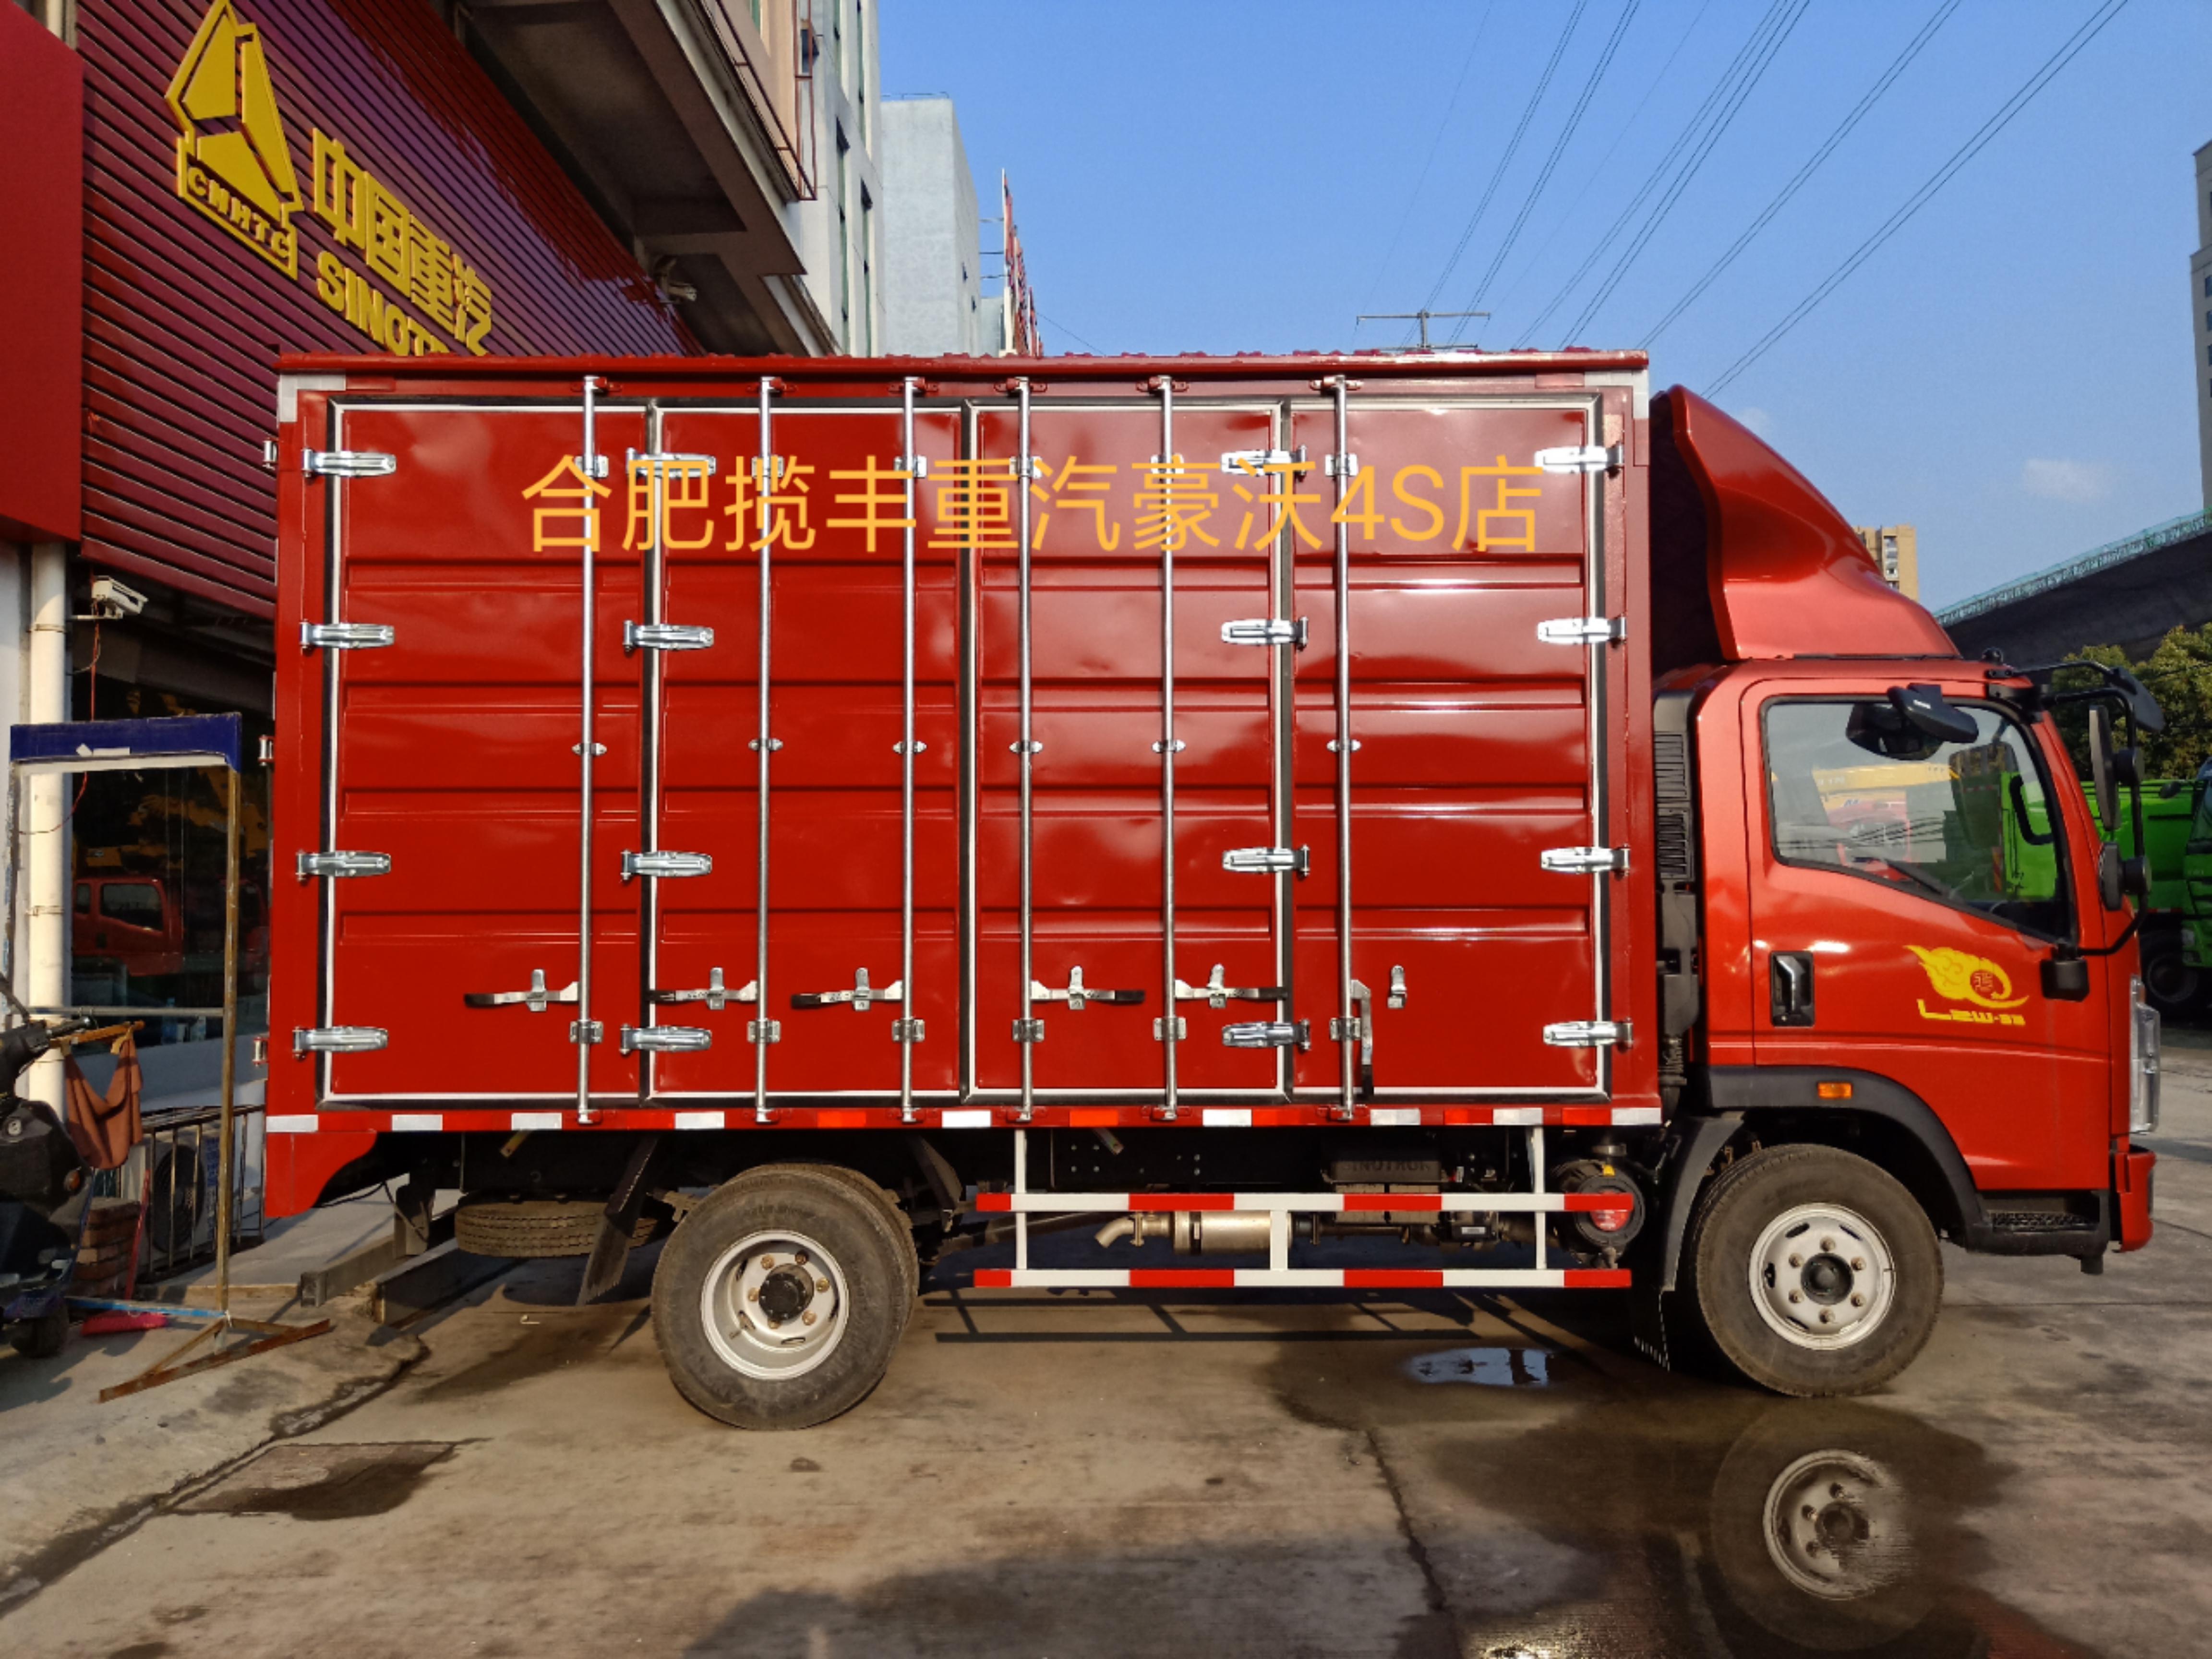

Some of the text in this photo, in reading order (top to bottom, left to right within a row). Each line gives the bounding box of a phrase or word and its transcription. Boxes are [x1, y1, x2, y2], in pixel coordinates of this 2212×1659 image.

[313, 128, 492, 356] 中国重汽
[316, 250, 450, 356] SINOT
